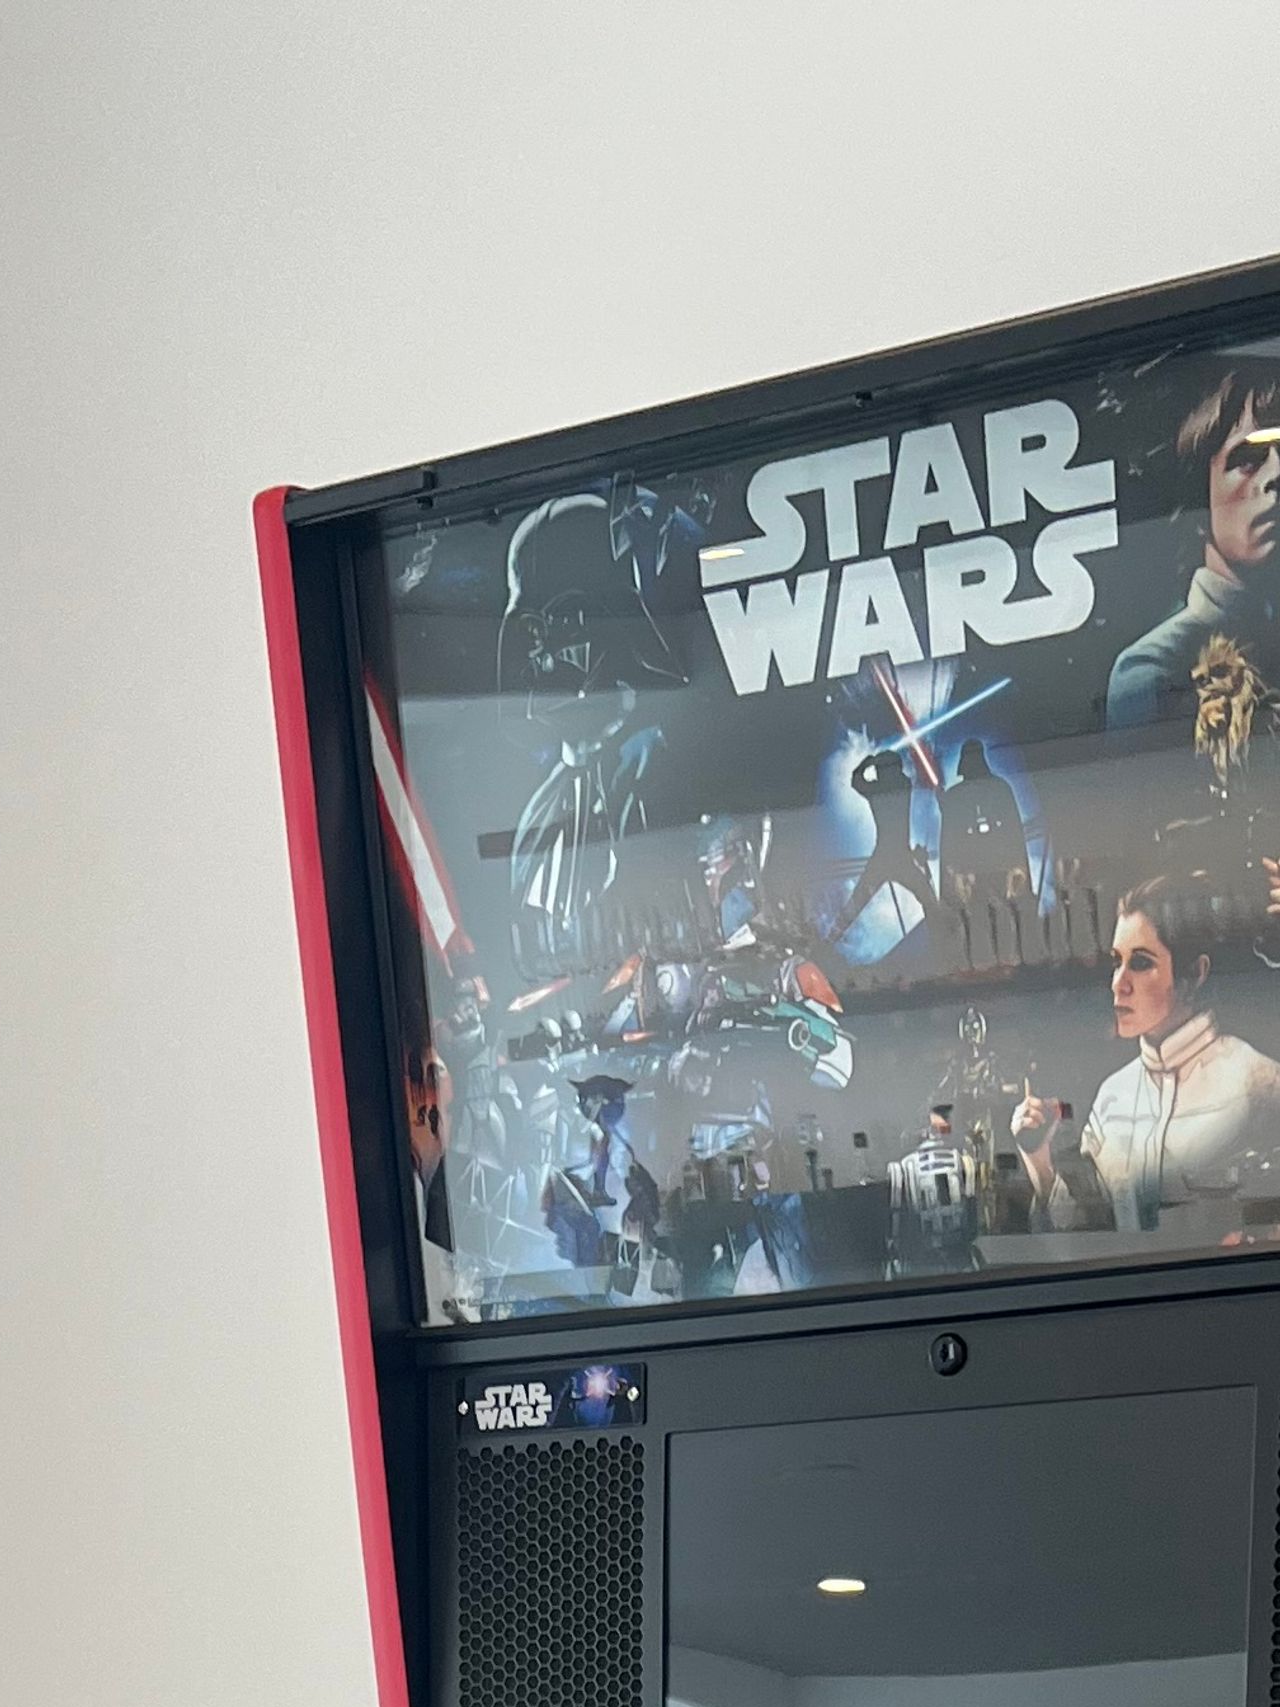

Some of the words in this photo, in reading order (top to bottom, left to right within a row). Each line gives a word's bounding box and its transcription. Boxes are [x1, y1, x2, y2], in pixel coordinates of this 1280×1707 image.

[699, 399, 1116, 588] STAR
[702, 508, 1118, 696] WARS
[475, 1382, 552, 1410] STAR
[475, 1404, 552, 1431] WARS
